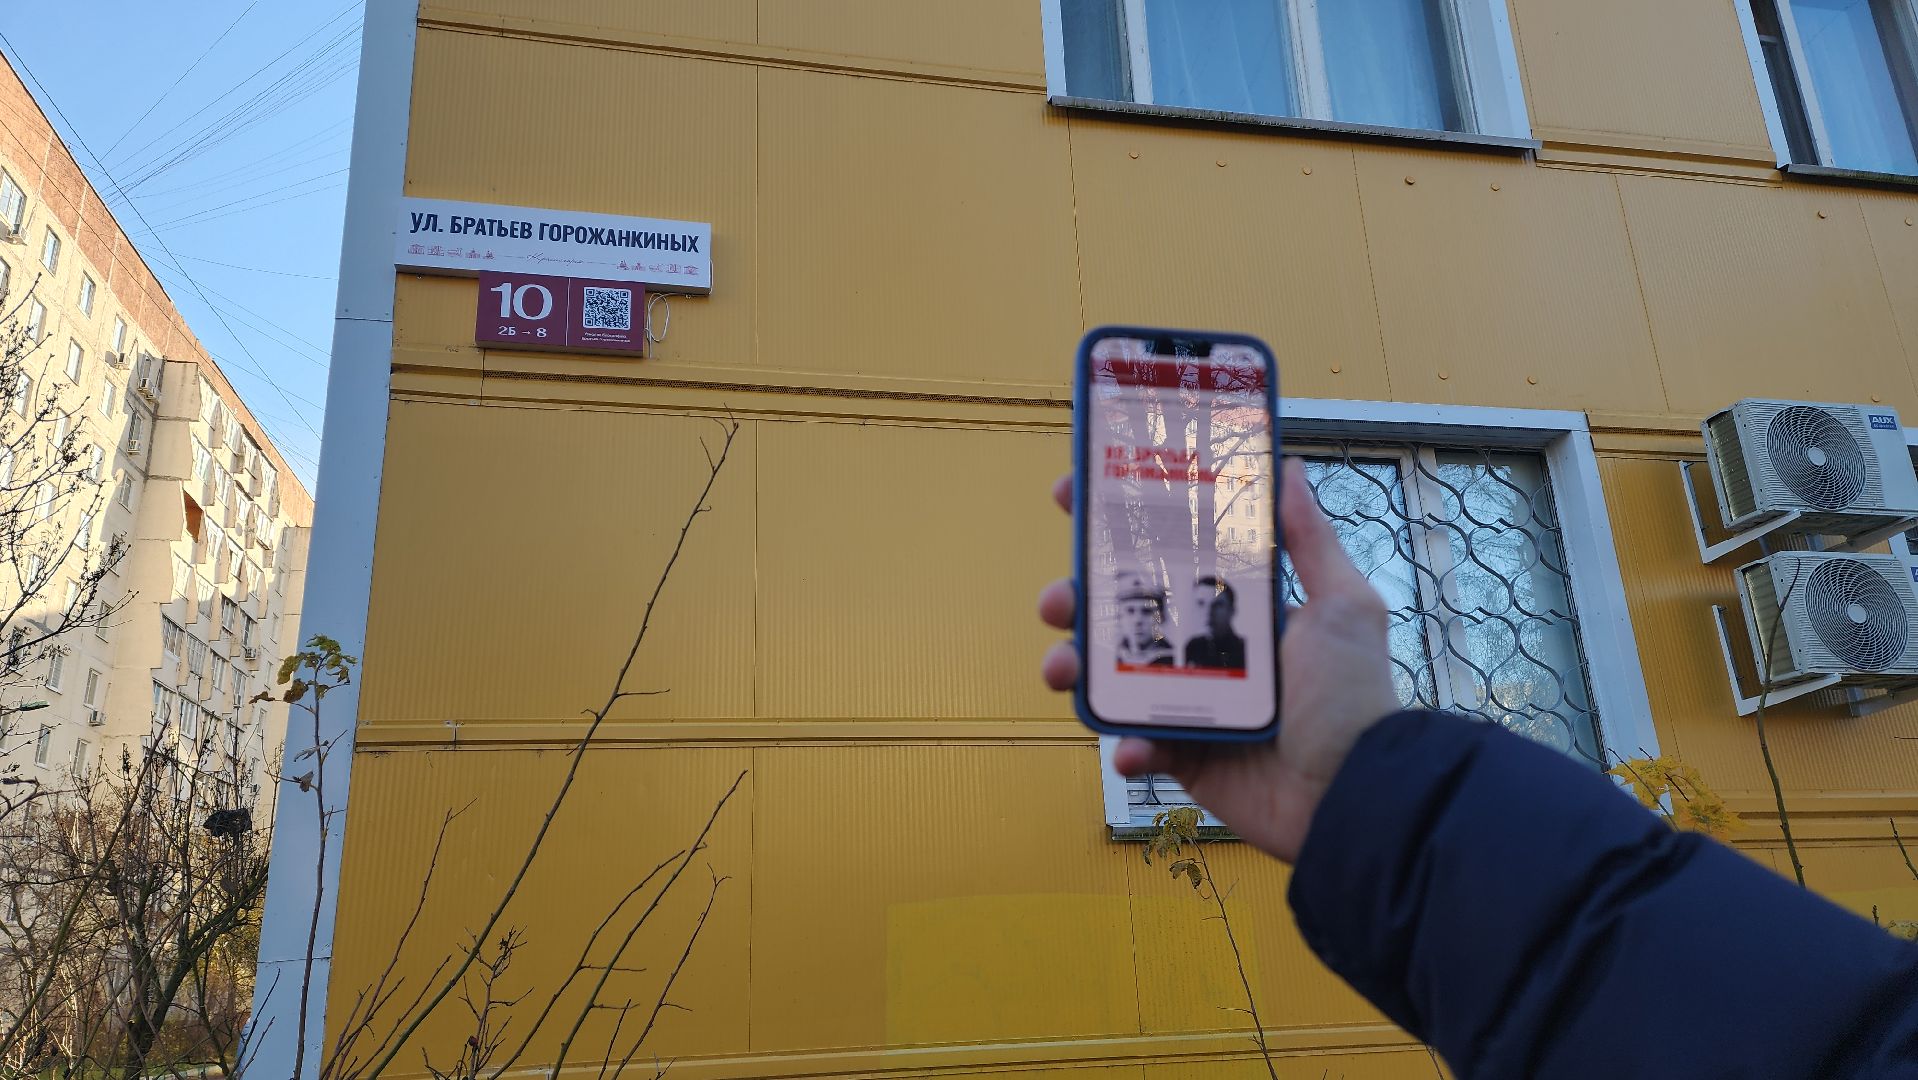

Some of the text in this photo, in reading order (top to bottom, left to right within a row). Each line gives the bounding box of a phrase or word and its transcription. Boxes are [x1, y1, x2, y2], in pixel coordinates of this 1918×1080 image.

[410, 212, 700, 254] УЛ. БРАТЬЕВ ГОРОЖАНКИНЫХ
[490, 282, 553, 320] 10
[497, 325, 547, 338] 2Б 8
[1872, 416, 1894, 424] AUX
